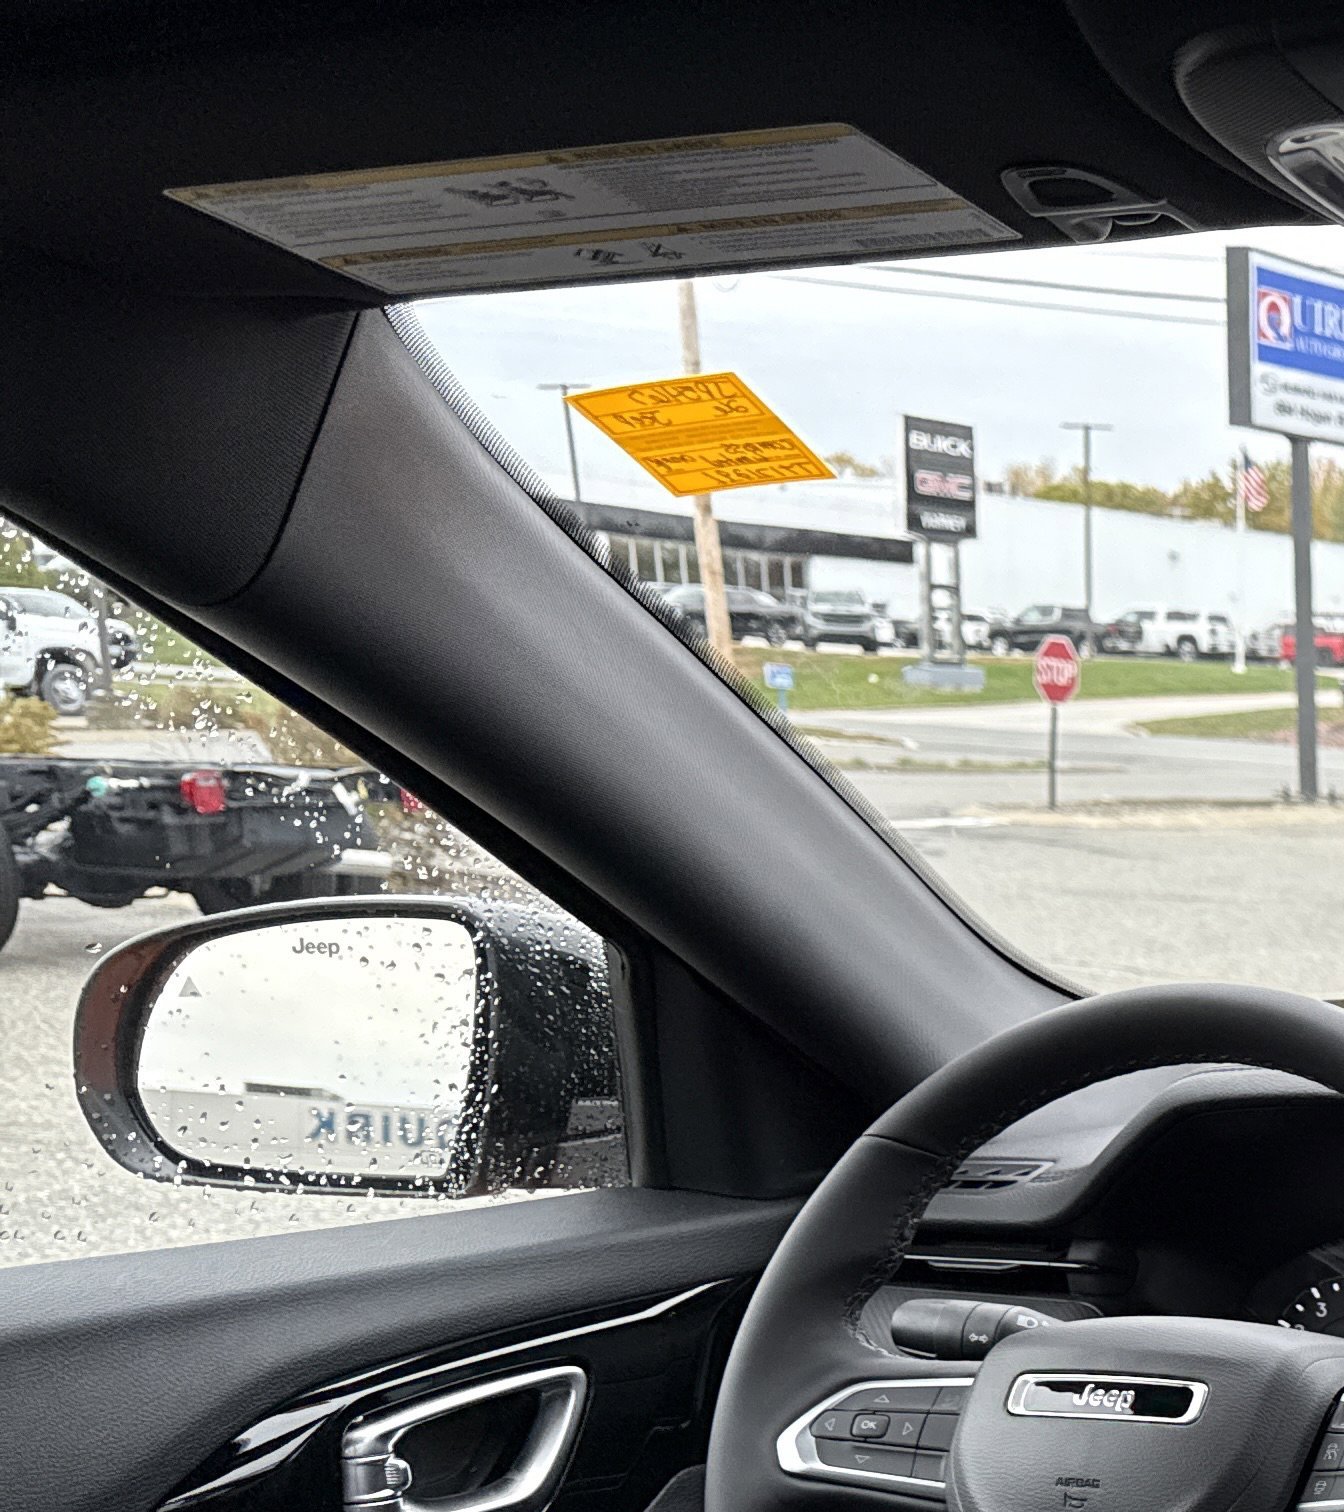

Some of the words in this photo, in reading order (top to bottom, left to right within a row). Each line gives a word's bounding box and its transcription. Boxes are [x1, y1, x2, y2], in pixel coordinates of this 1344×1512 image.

[908, 430, 973, 459] BUICK
[914, 469, 973, 501] GMC
[1036, 656, 1078, 686] STOP
[292, 938, 340, 957] Jeep
[1315, 1302, 1328, 1318] 3
[1072, 1383, 1136, 1412] Jeep
[860, 1420, 877, 1431] OK
[1055, 1476, 1101, 1489] AIRBAG
